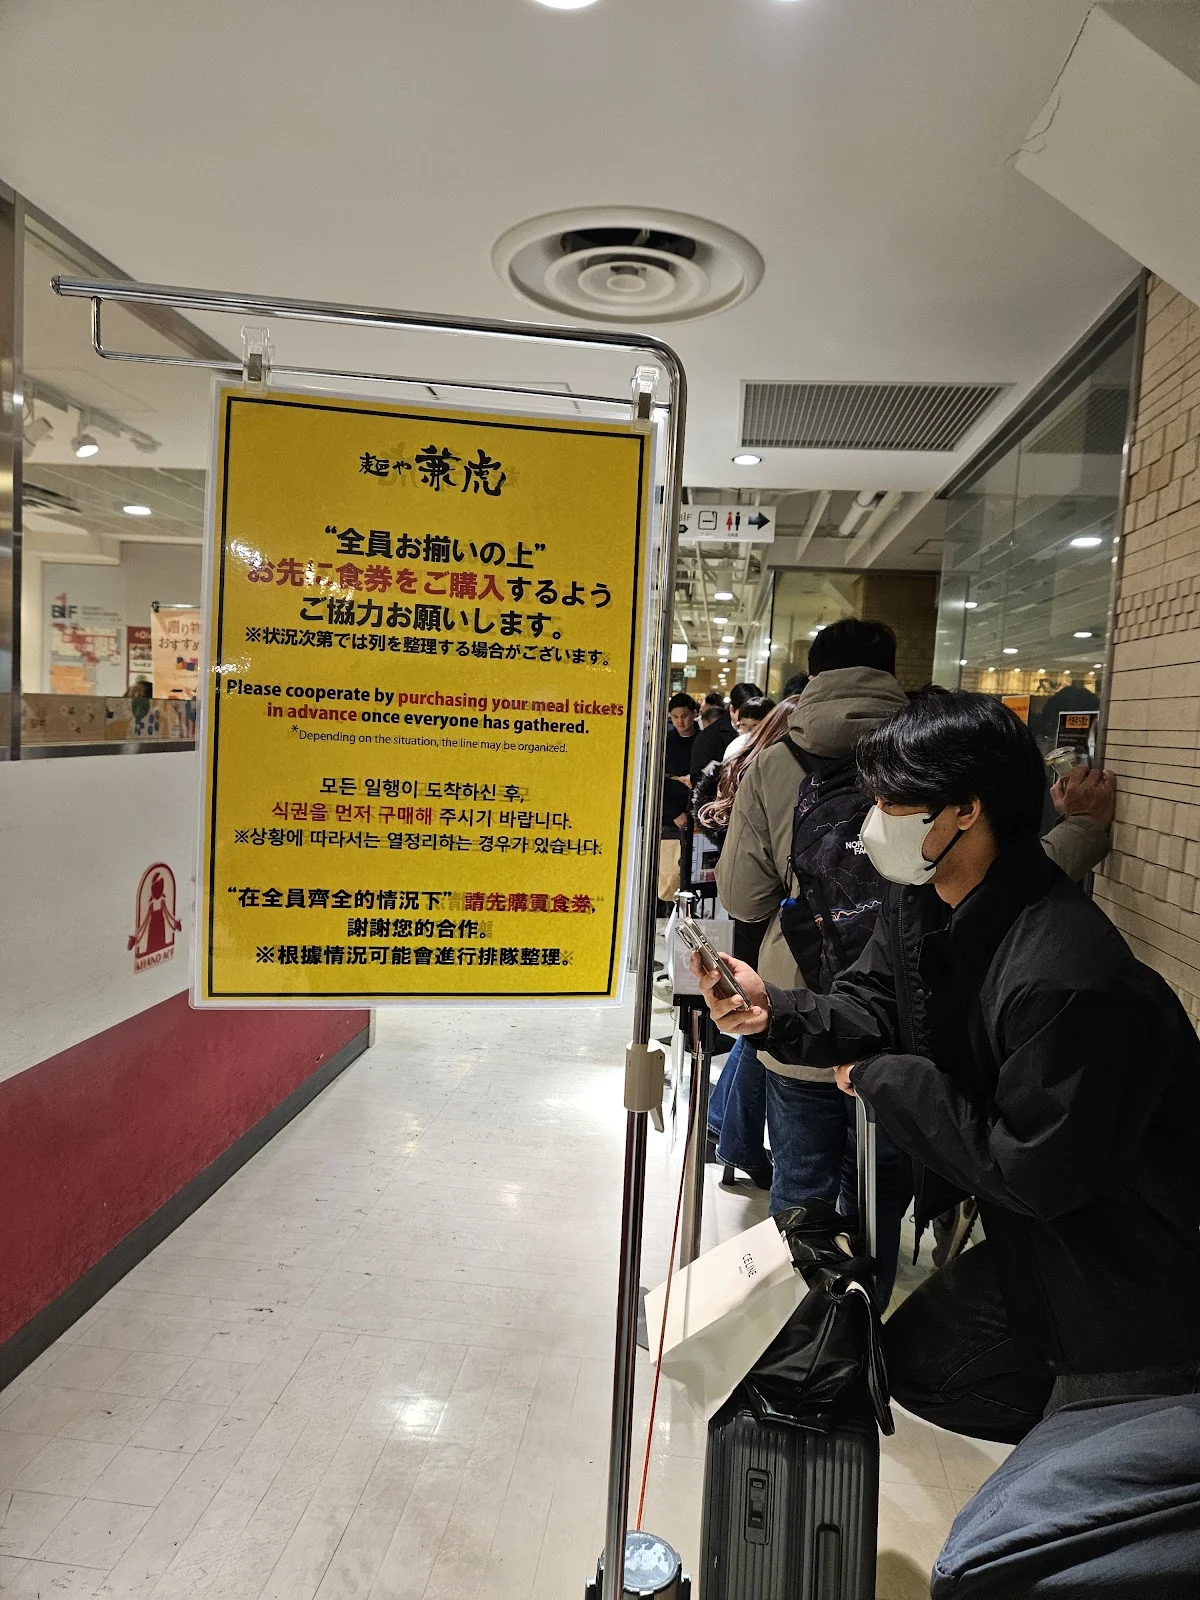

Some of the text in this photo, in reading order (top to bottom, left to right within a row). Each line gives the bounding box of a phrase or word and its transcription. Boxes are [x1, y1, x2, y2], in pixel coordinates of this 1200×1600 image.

[325, 525, 546, 569] “全員お揃いの上”
[248, 557, 611, 609] お先に食券をご購入するよう
[300, 596, 561, 640] ご協力お願いします。
[227, 679, 624, 716] Please cooperate by purchasing your meal tickets
[267, 702, 589, 734] in advance once everyone has gathered.
[358, 733, 372, 743] on
[374, 734, 391, 744] the
[393, 735, 439, 748] situation,
[441, 738, 458, 748] the
[460, 738, 478, 749] line
[480, 741, 501, 751] may
[503, 740, 516, 751] be
[518, 742, 568, 754] organized.
[320, 777, 524, 804] 모든 일행이 도착하신 후,
[271, 802, 572, 830] 식권을 먼저 구매해 주시기 바랍니다.
[234, 828, 602, 855] ※상황에 따라서는 열정리하는 경우가 있습니다.
[845, 841, 864, 849] NOR
[227, 886, 596, 913] “在全員齊全的情況下” 請先購買食券,
[347, 918, 488, 938] 謝謝您的合作。
[256, 945, 569, 965] ※根據情況可能會進行排隊整理。
[742, 1253, 757, 1278] CELINE
